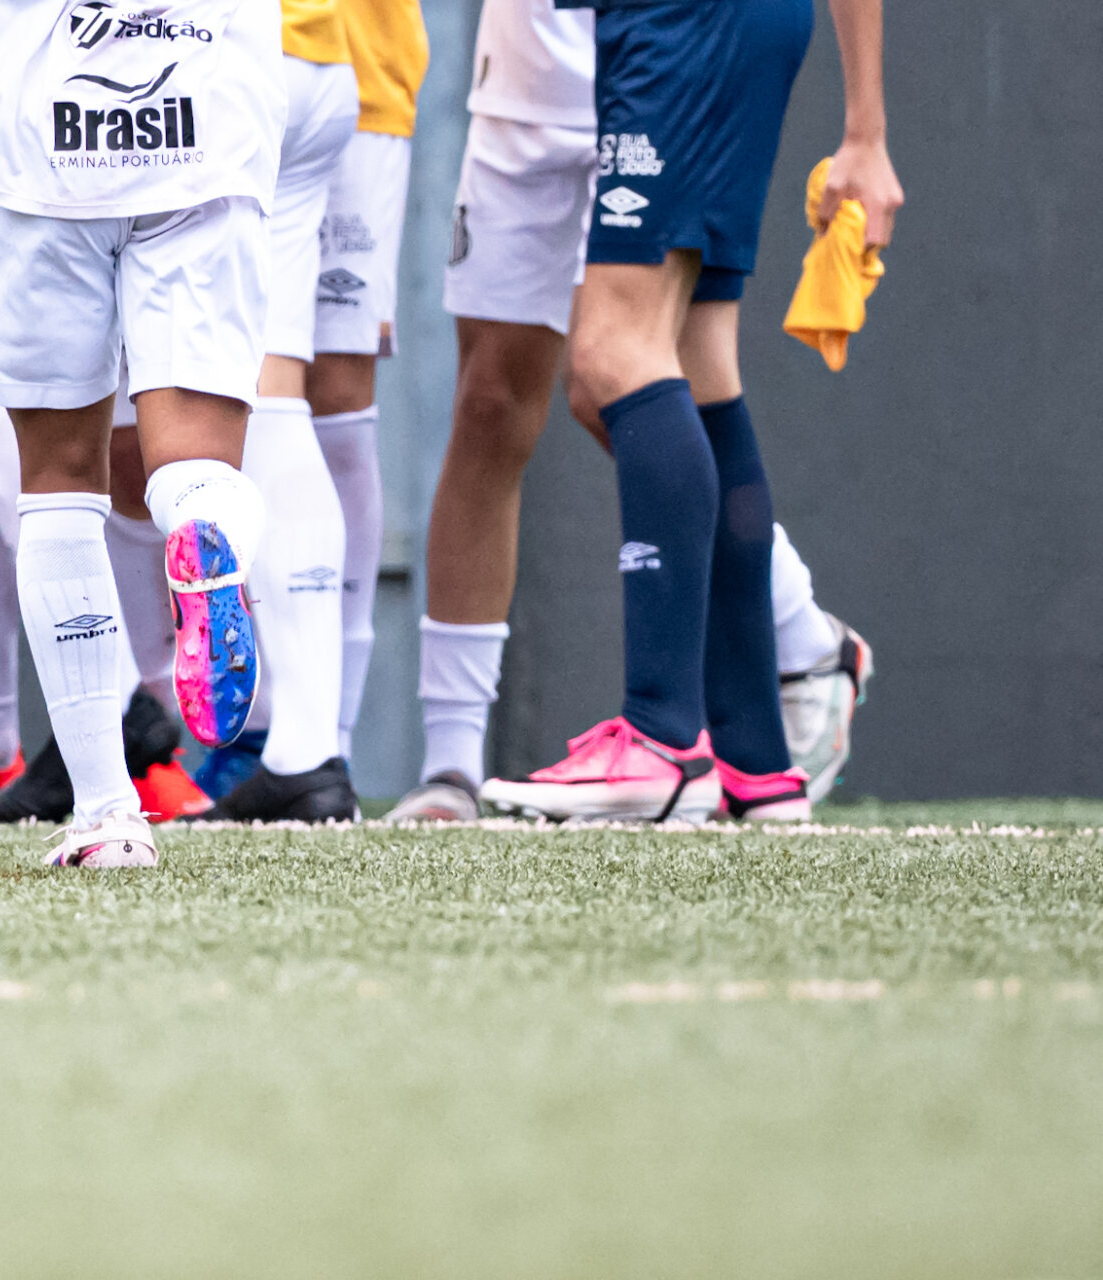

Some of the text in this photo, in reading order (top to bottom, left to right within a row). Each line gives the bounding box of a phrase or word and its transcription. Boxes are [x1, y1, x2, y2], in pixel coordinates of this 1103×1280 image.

[113, 18, 213, 43] Tadição
[53, 97, 195, 151] Brasil
[50, 150, 204, 169] ERMINAL PORTUÁRIO
